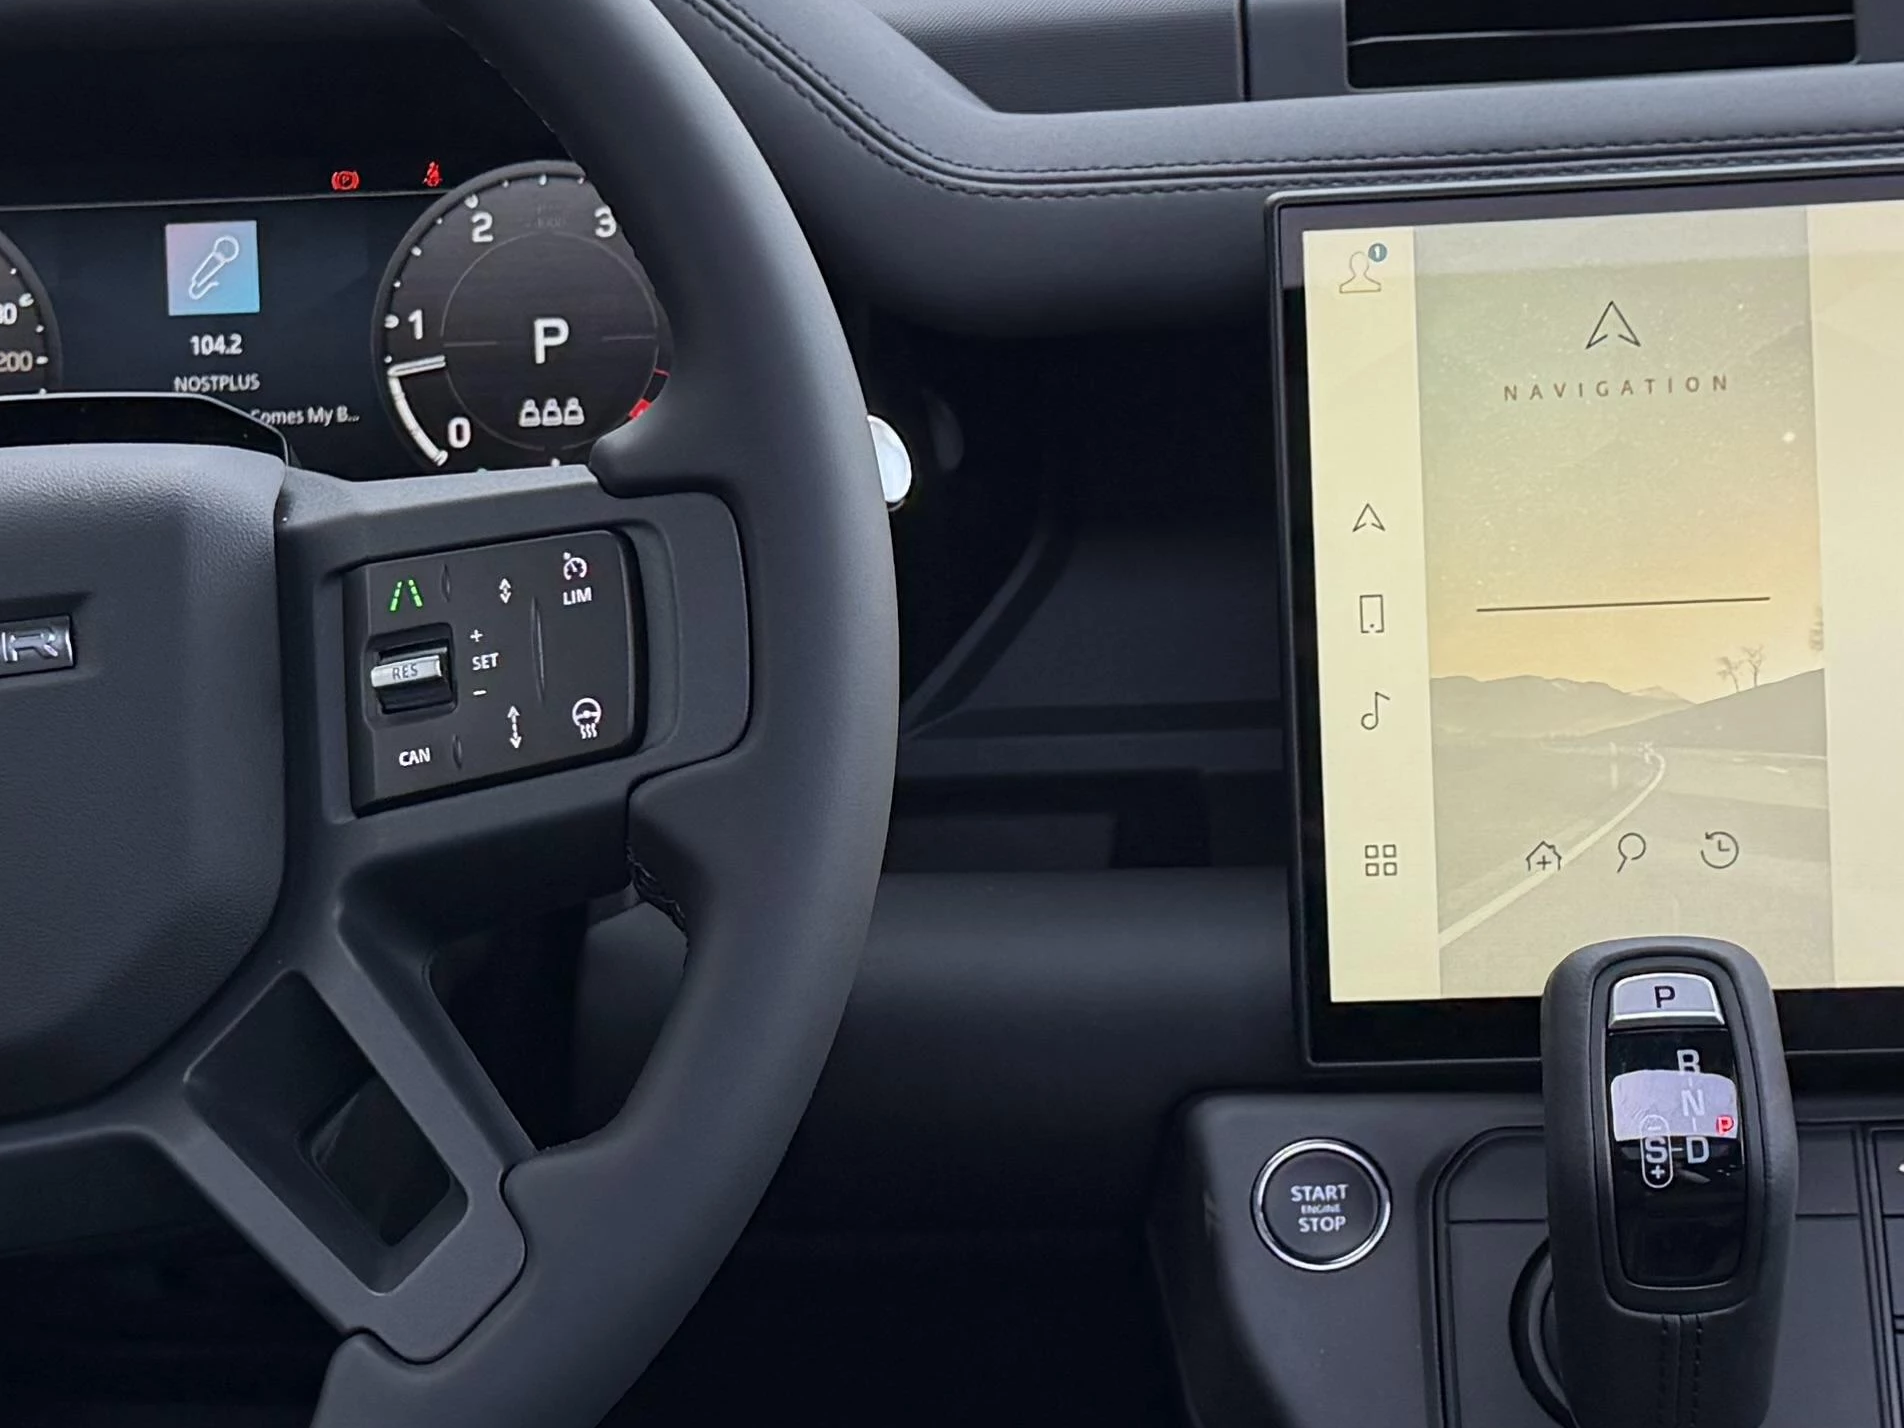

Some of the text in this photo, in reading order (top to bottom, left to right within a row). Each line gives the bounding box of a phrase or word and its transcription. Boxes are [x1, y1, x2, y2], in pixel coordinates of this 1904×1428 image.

[471, 211, 495, 243] 2
[595, 205, 617, 238] 3
[407, 308, 424, 340] 1
[189, 333, 243, 356] 104.2
[533, 316, 571, 365] P
[173, 373, 261, 393] NOSTPLUS
[1503, 374, 1730, 402] NAVIGATION
[307, 406, 334, 427] My
[447, 416, 472, 449] 0
[562, 586, 593, 606] LIM
[391, 663, 419, 680] RES
[472, 652, 499, 671] SET
[398, 747, 431, 767] CAN
[1654, 985, 1676, 1008] P
[1676, 1049, 1701, 1075] R
[1681, 1089, 1706, 1117] N
[1715, 1115, 1735, 1136] P
[1645, 1135, 1710, 1164] S D
[1290, 1184, 1349, 1202] START
[1301, 1203, 1341, 1215] ENGINE
[1298, 1216, 1347, 1233] STOP
